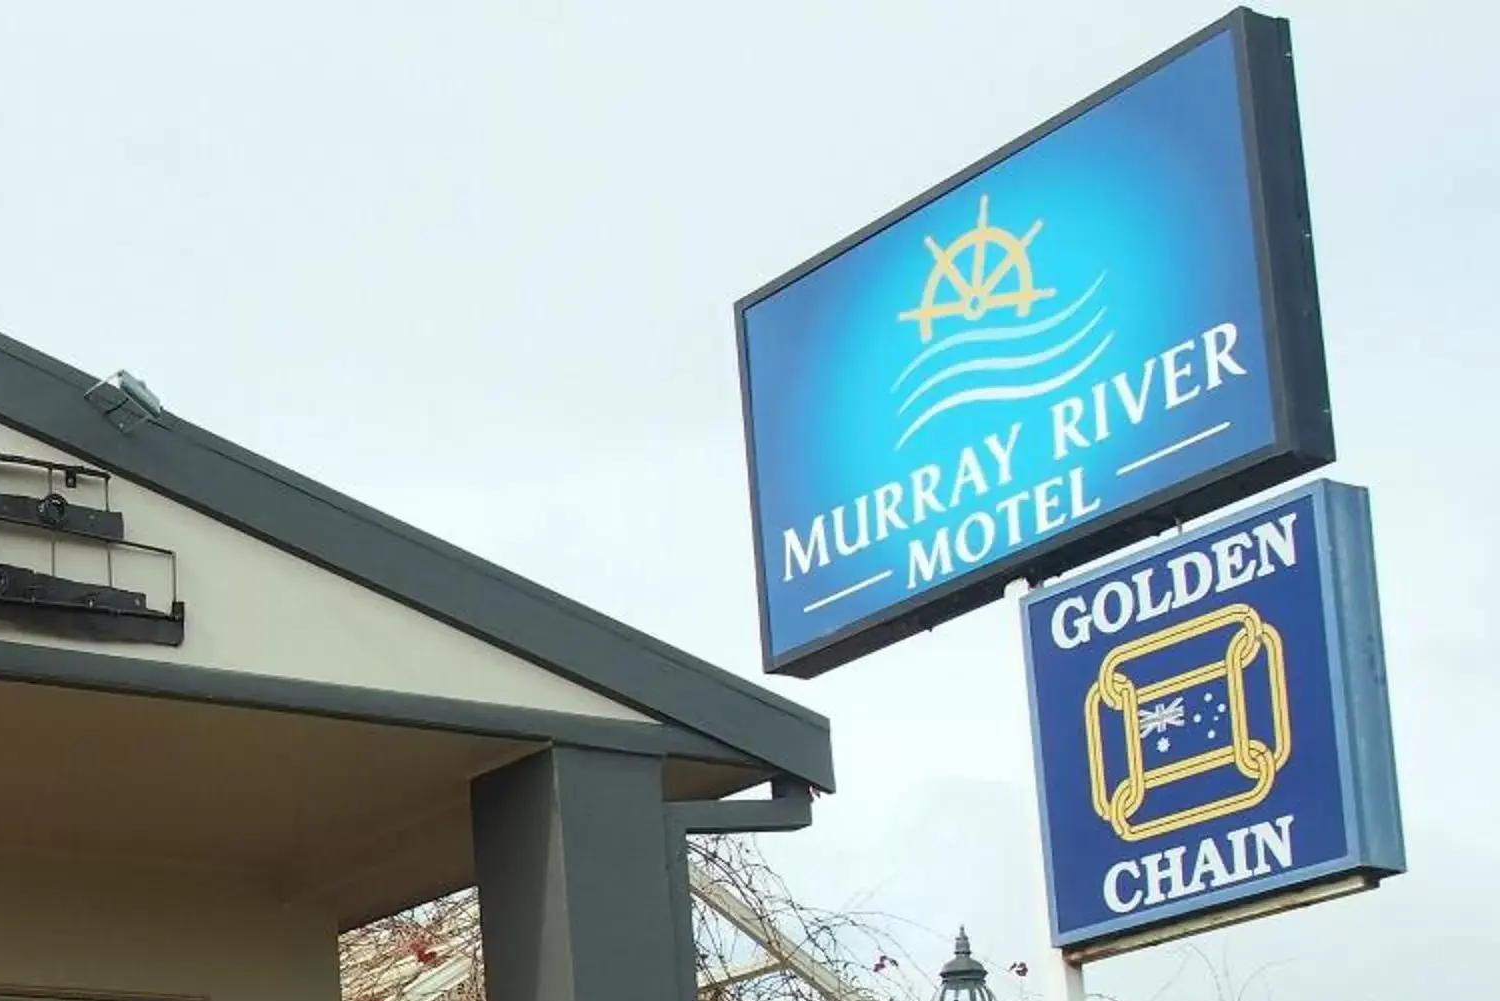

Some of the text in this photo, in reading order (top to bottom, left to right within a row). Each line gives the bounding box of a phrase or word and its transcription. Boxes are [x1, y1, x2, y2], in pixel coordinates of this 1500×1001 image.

[781, 321, 1247, 582] MURRAY RIVER
[906, 466, 1102, 590] MOTEL
[1050, 512, 1300, 651] GOLDEN
[1102, 815, 1296, 914] CHAIN
